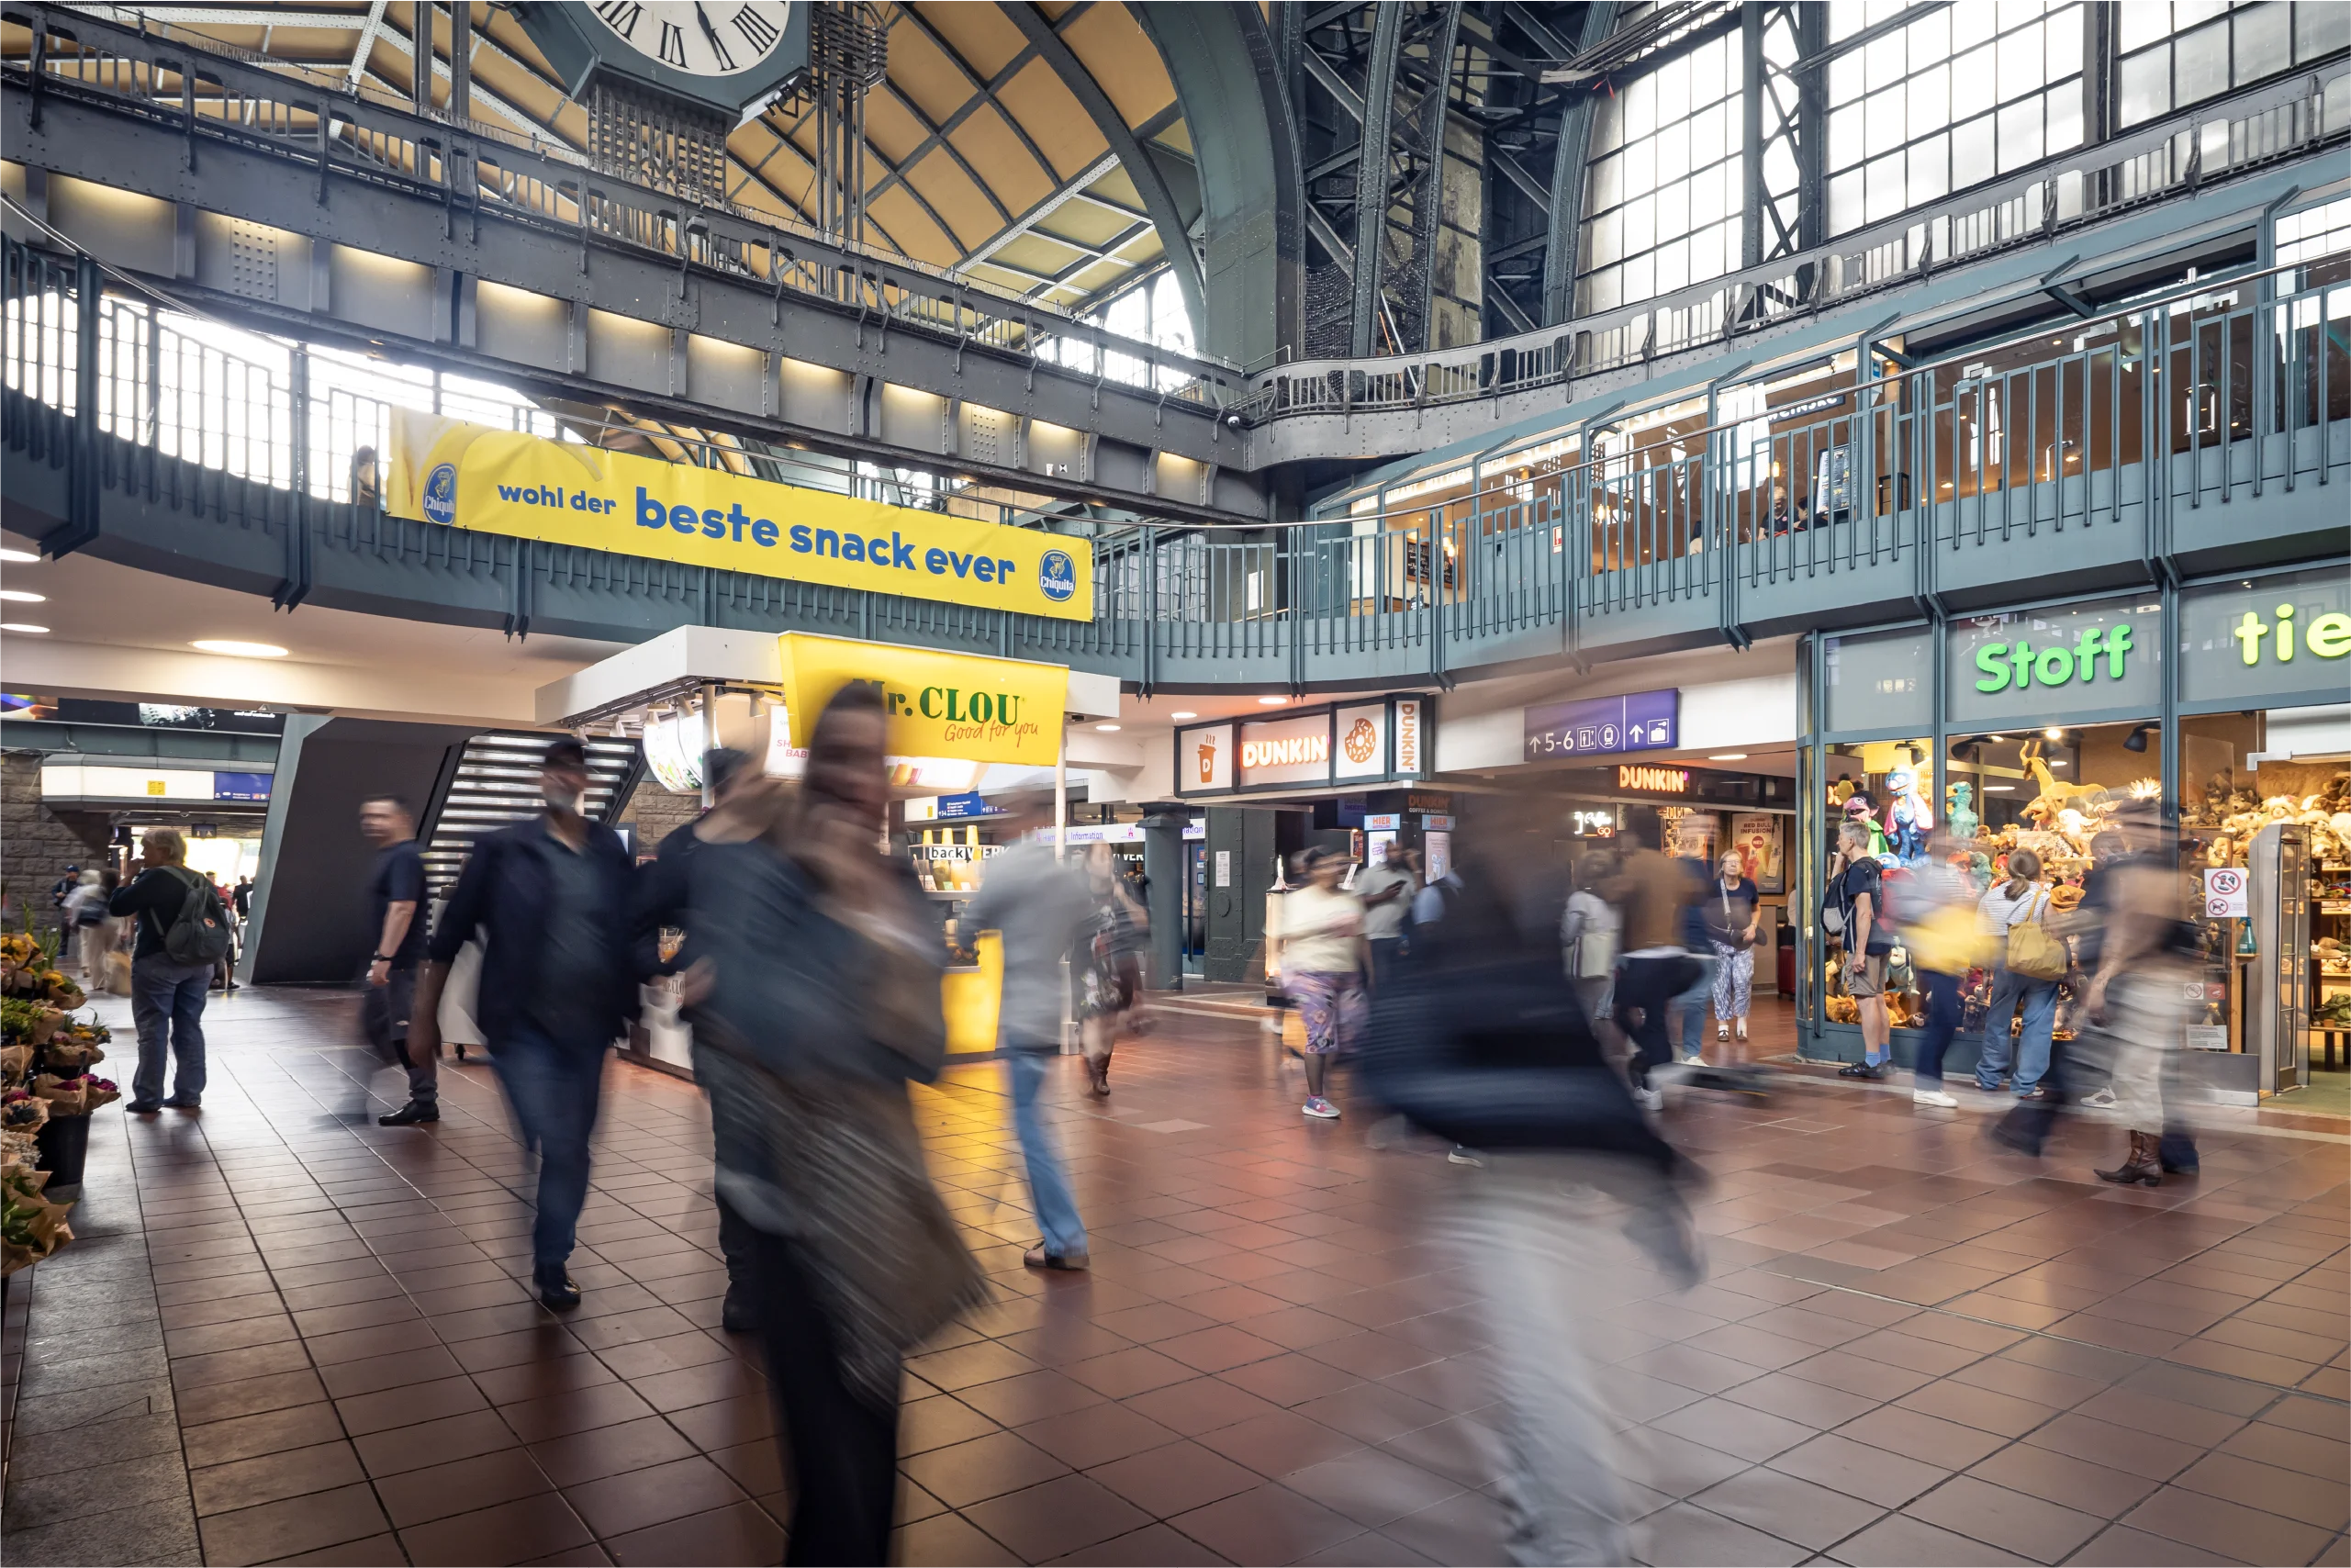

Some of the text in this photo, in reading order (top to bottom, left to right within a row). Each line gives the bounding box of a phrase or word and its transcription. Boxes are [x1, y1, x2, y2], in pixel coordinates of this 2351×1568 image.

[498, 485, 1015, 584] wohl der beste snack ever
[1040, 576, 1074, 593] Chiquita
[2234, 603, 2351, 666] tie
[1975, 624, 2133, 693] Stoff
[919, 687, 1020, 726] CLOU
[945, 719, 1038, 748] Good for you
[1401, 703, 1415, 771] DUNKIN'
[1544, 731, 1574, 752] 5-6
[1619, 765, 1689, 792] DUNKIN'
[1372, 816, 1391, 824] HIER
[1430, 817, 1448, 825] HIER
[1070, 830, 1103, 840] Information
